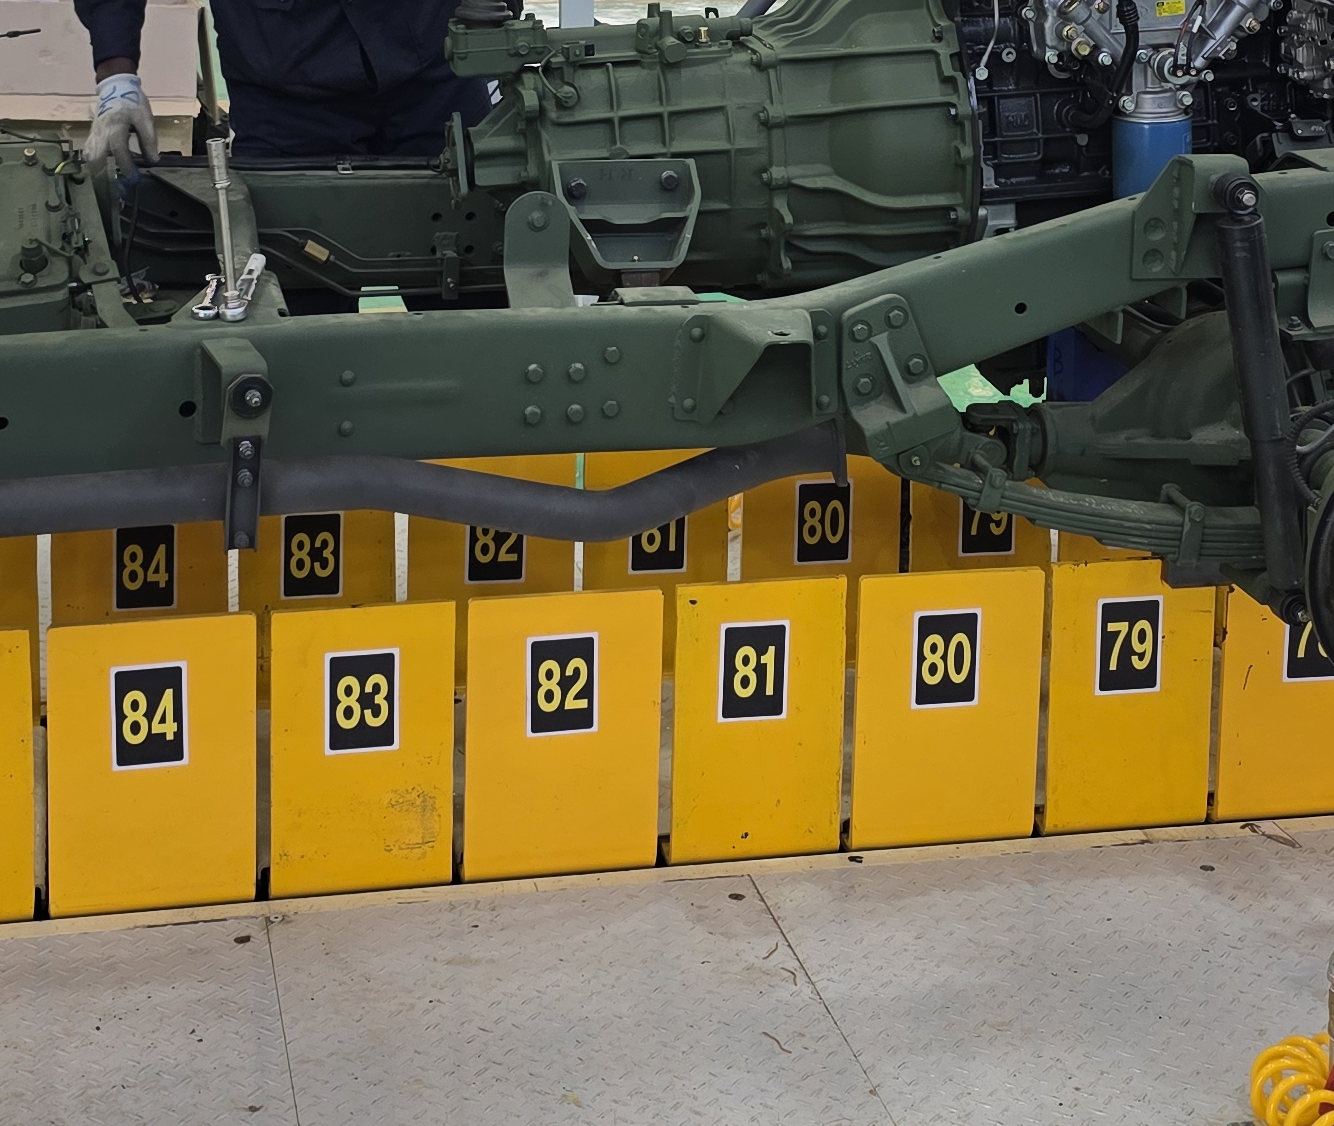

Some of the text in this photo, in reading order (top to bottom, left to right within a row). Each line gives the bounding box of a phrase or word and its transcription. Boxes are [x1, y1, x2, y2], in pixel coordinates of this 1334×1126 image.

[475, 526, 517, 563] 82
[802, 499, 845, 545] 80
[122, 543, 169, 591] 84
[289, 531, 335, 579] 83
[921, 632, 972, 685] 80
[1106, 619, 1153, 671] 79
[1297, 621, 1327, 658] 7
[537, 657, 589, 713] 82
[733, 645, 776, 698] 81
[122, 688, 178, 745] 84
[335, 673, 389, 730] 83
